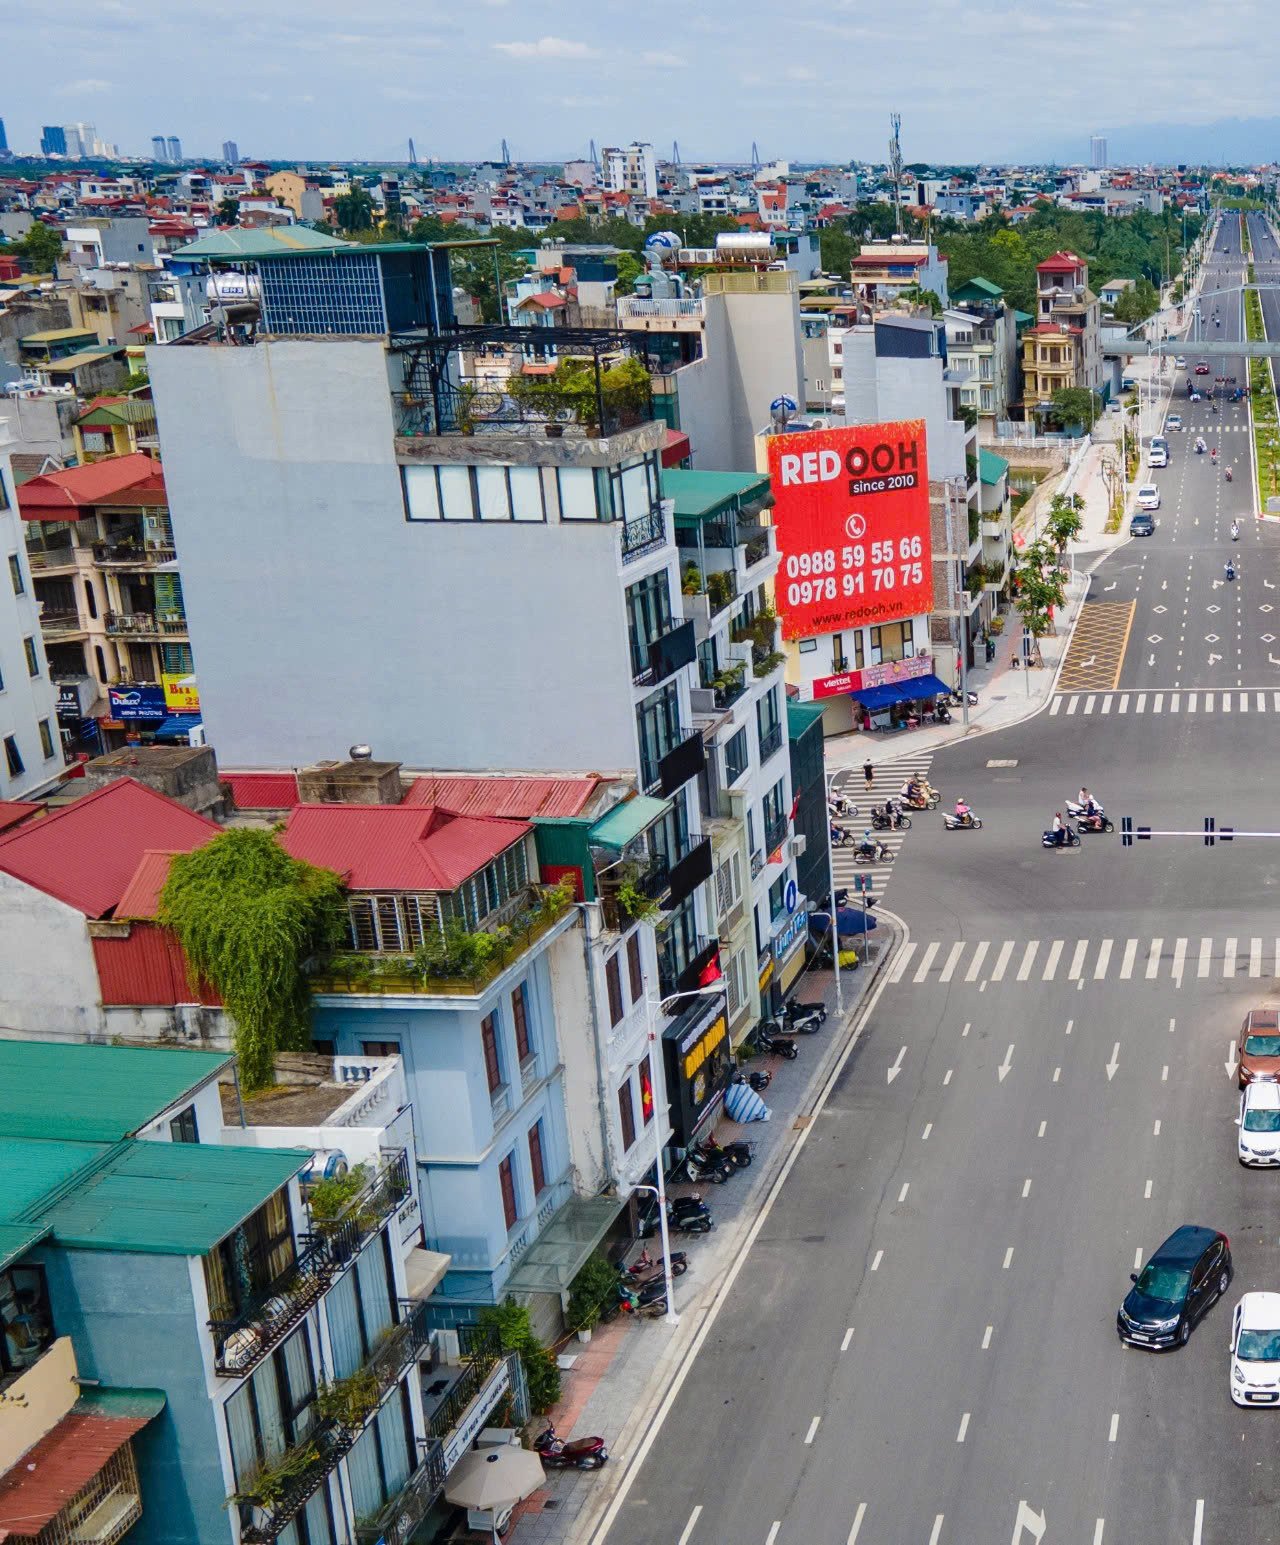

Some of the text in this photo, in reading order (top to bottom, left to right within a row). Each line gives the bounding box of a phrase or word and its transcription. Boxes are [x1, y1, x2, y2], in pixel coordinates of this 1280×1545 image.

[781, 441, 918, 486] RED OOH
[853, 475, 914, 493] since 2010
[786, 536, 922, 579] 0988 59 55 66
[788, 562, 923, 606] 0978 91 70 75
[812, 601, 904, 626] www.redooh.vn
[823, 676, 851, 688] viettel
[112, 697, 140, 706] Dulux
